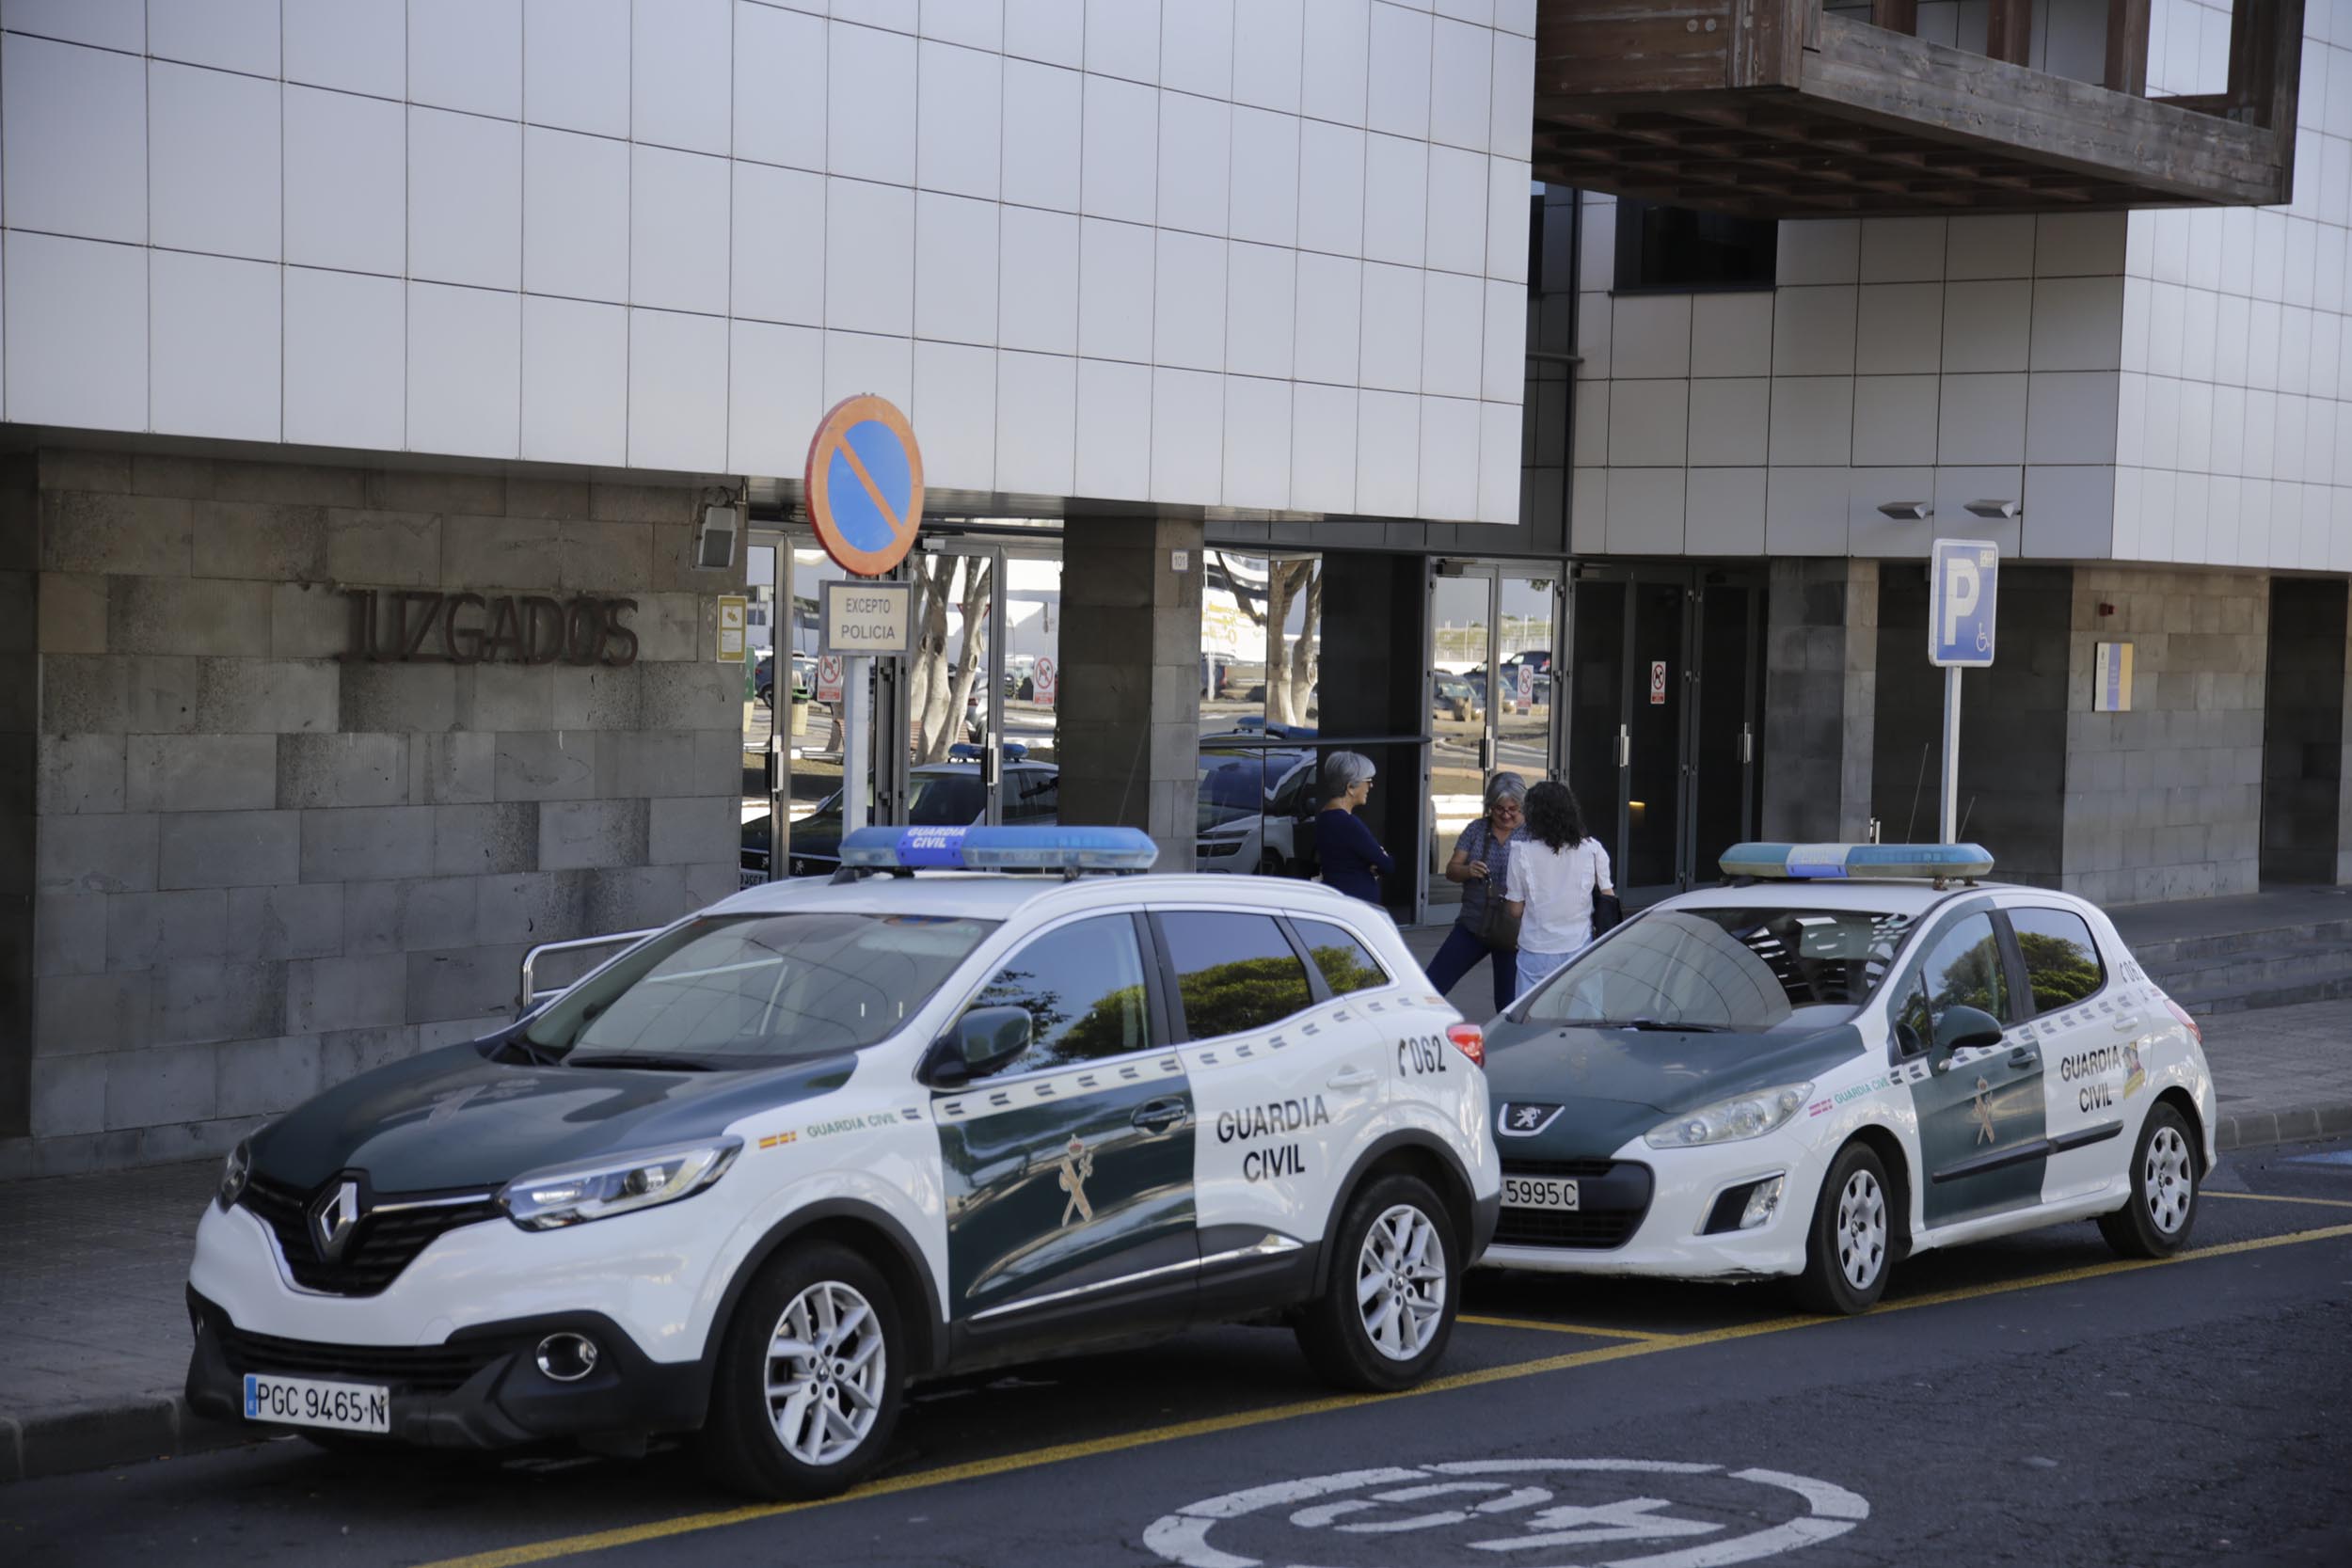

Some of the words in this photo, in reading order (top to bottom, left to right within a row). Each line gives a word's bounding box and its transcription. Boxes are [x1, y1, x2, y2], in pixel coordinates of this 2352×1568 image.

[846, 597, 891, 614] EXCEPTO
[1945, 558, 1979, 646] P
[335, 589, 639, 667] JUZGADOS
[841, 625, 896, 640] POLICIA
[907, 827, 966, 837] GUARDIA
[912, 837, 946, 849] CIVIL
[1409, 1035, 1446, 1075] 062
[2060, 1045, 2122, 1083] GUARDIA
[1835, 1084, 1872, 1105] GUARDIA
[1872, 1077, 1890, 1091] CIVIL
[2078, 1083, 2113, 1114] CIVIL
[807, 1118, 866, 1138] GUARDIA
[867, 1113, 898, 1127] CIVIL
[1216, 1094, 1329, 1144] GUARDIA
[1243, 1144, 1306, 1183] CIVIL
[257, 1383, 298, 1417] PGC
